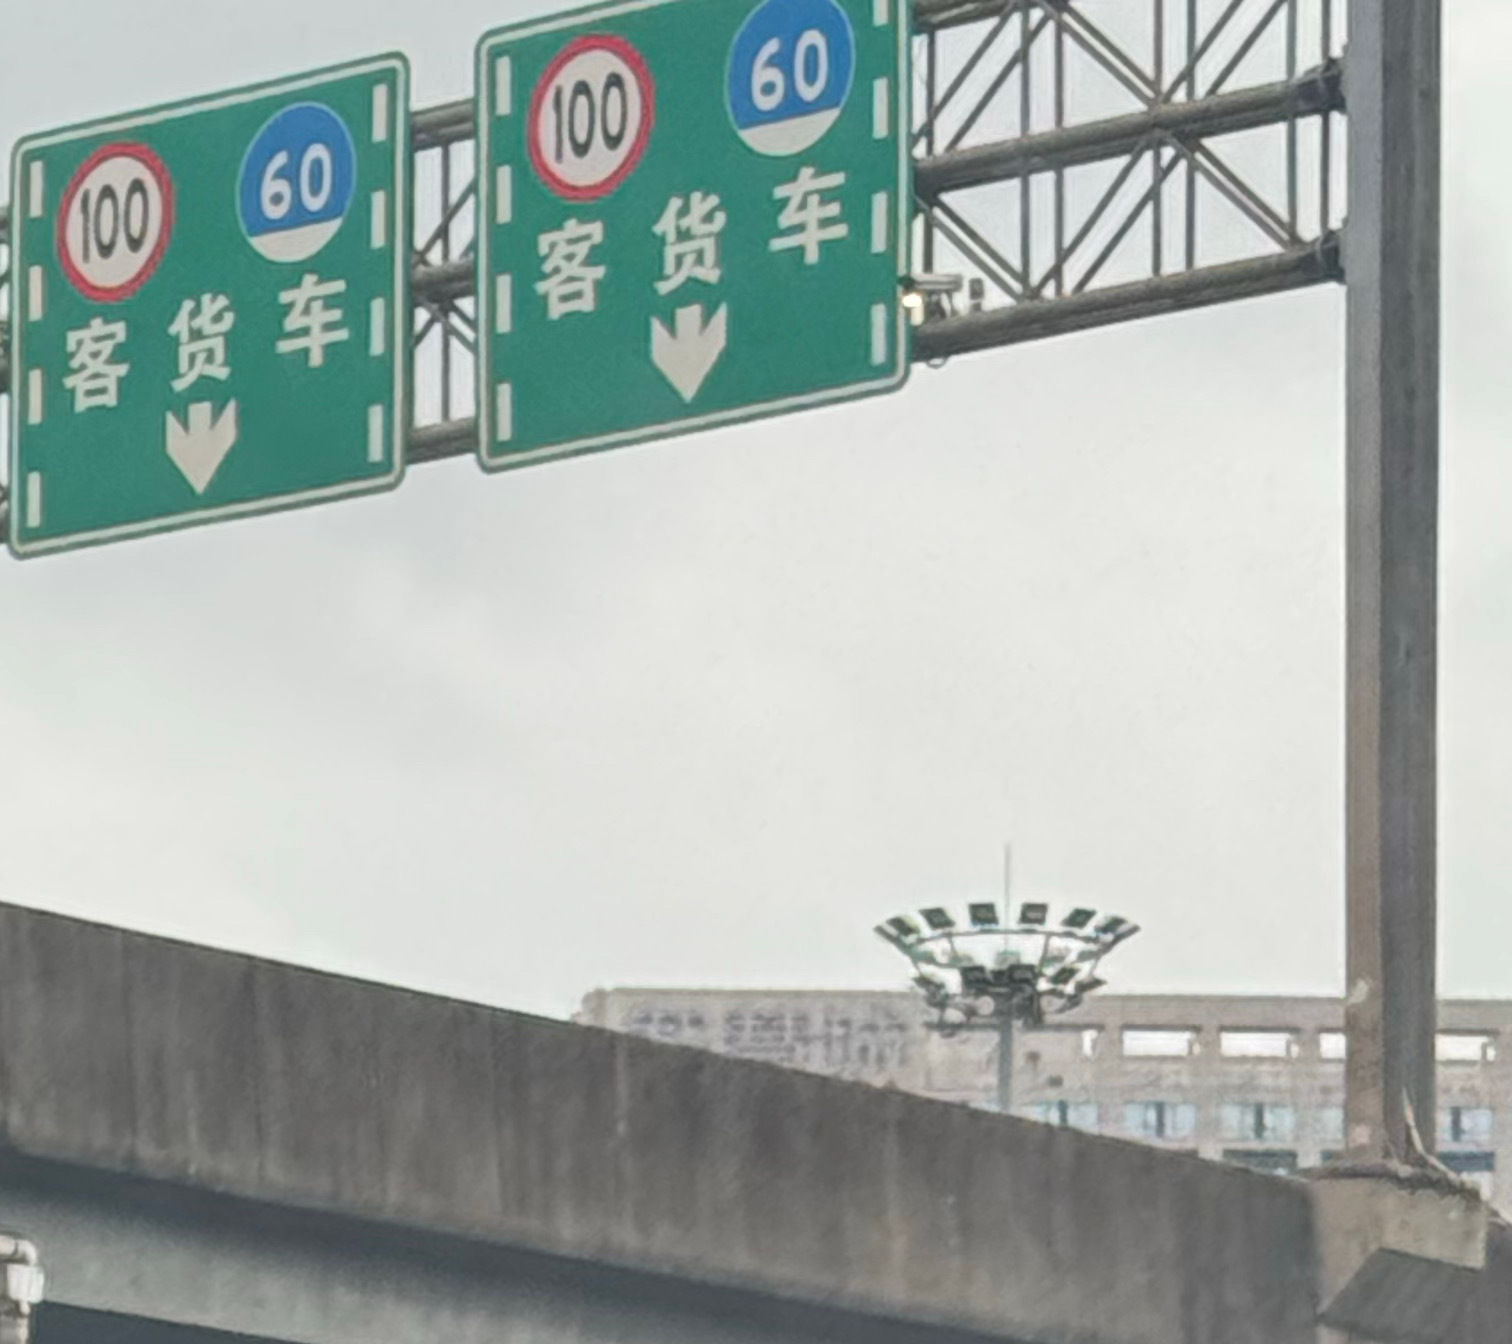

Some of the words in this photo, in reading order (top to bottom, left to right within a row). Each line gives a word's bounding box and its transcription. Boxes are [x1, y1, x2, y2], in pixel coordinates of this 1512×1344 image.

[750, 28, 830, 113] 60
[553, 71, 629, 165] 100
[80, 177, 150, 264] 100
[259, 142, 334, 221] 60
[534, 166, 849, 320] 客货车
[62, 272, 351, 414] 客货车
